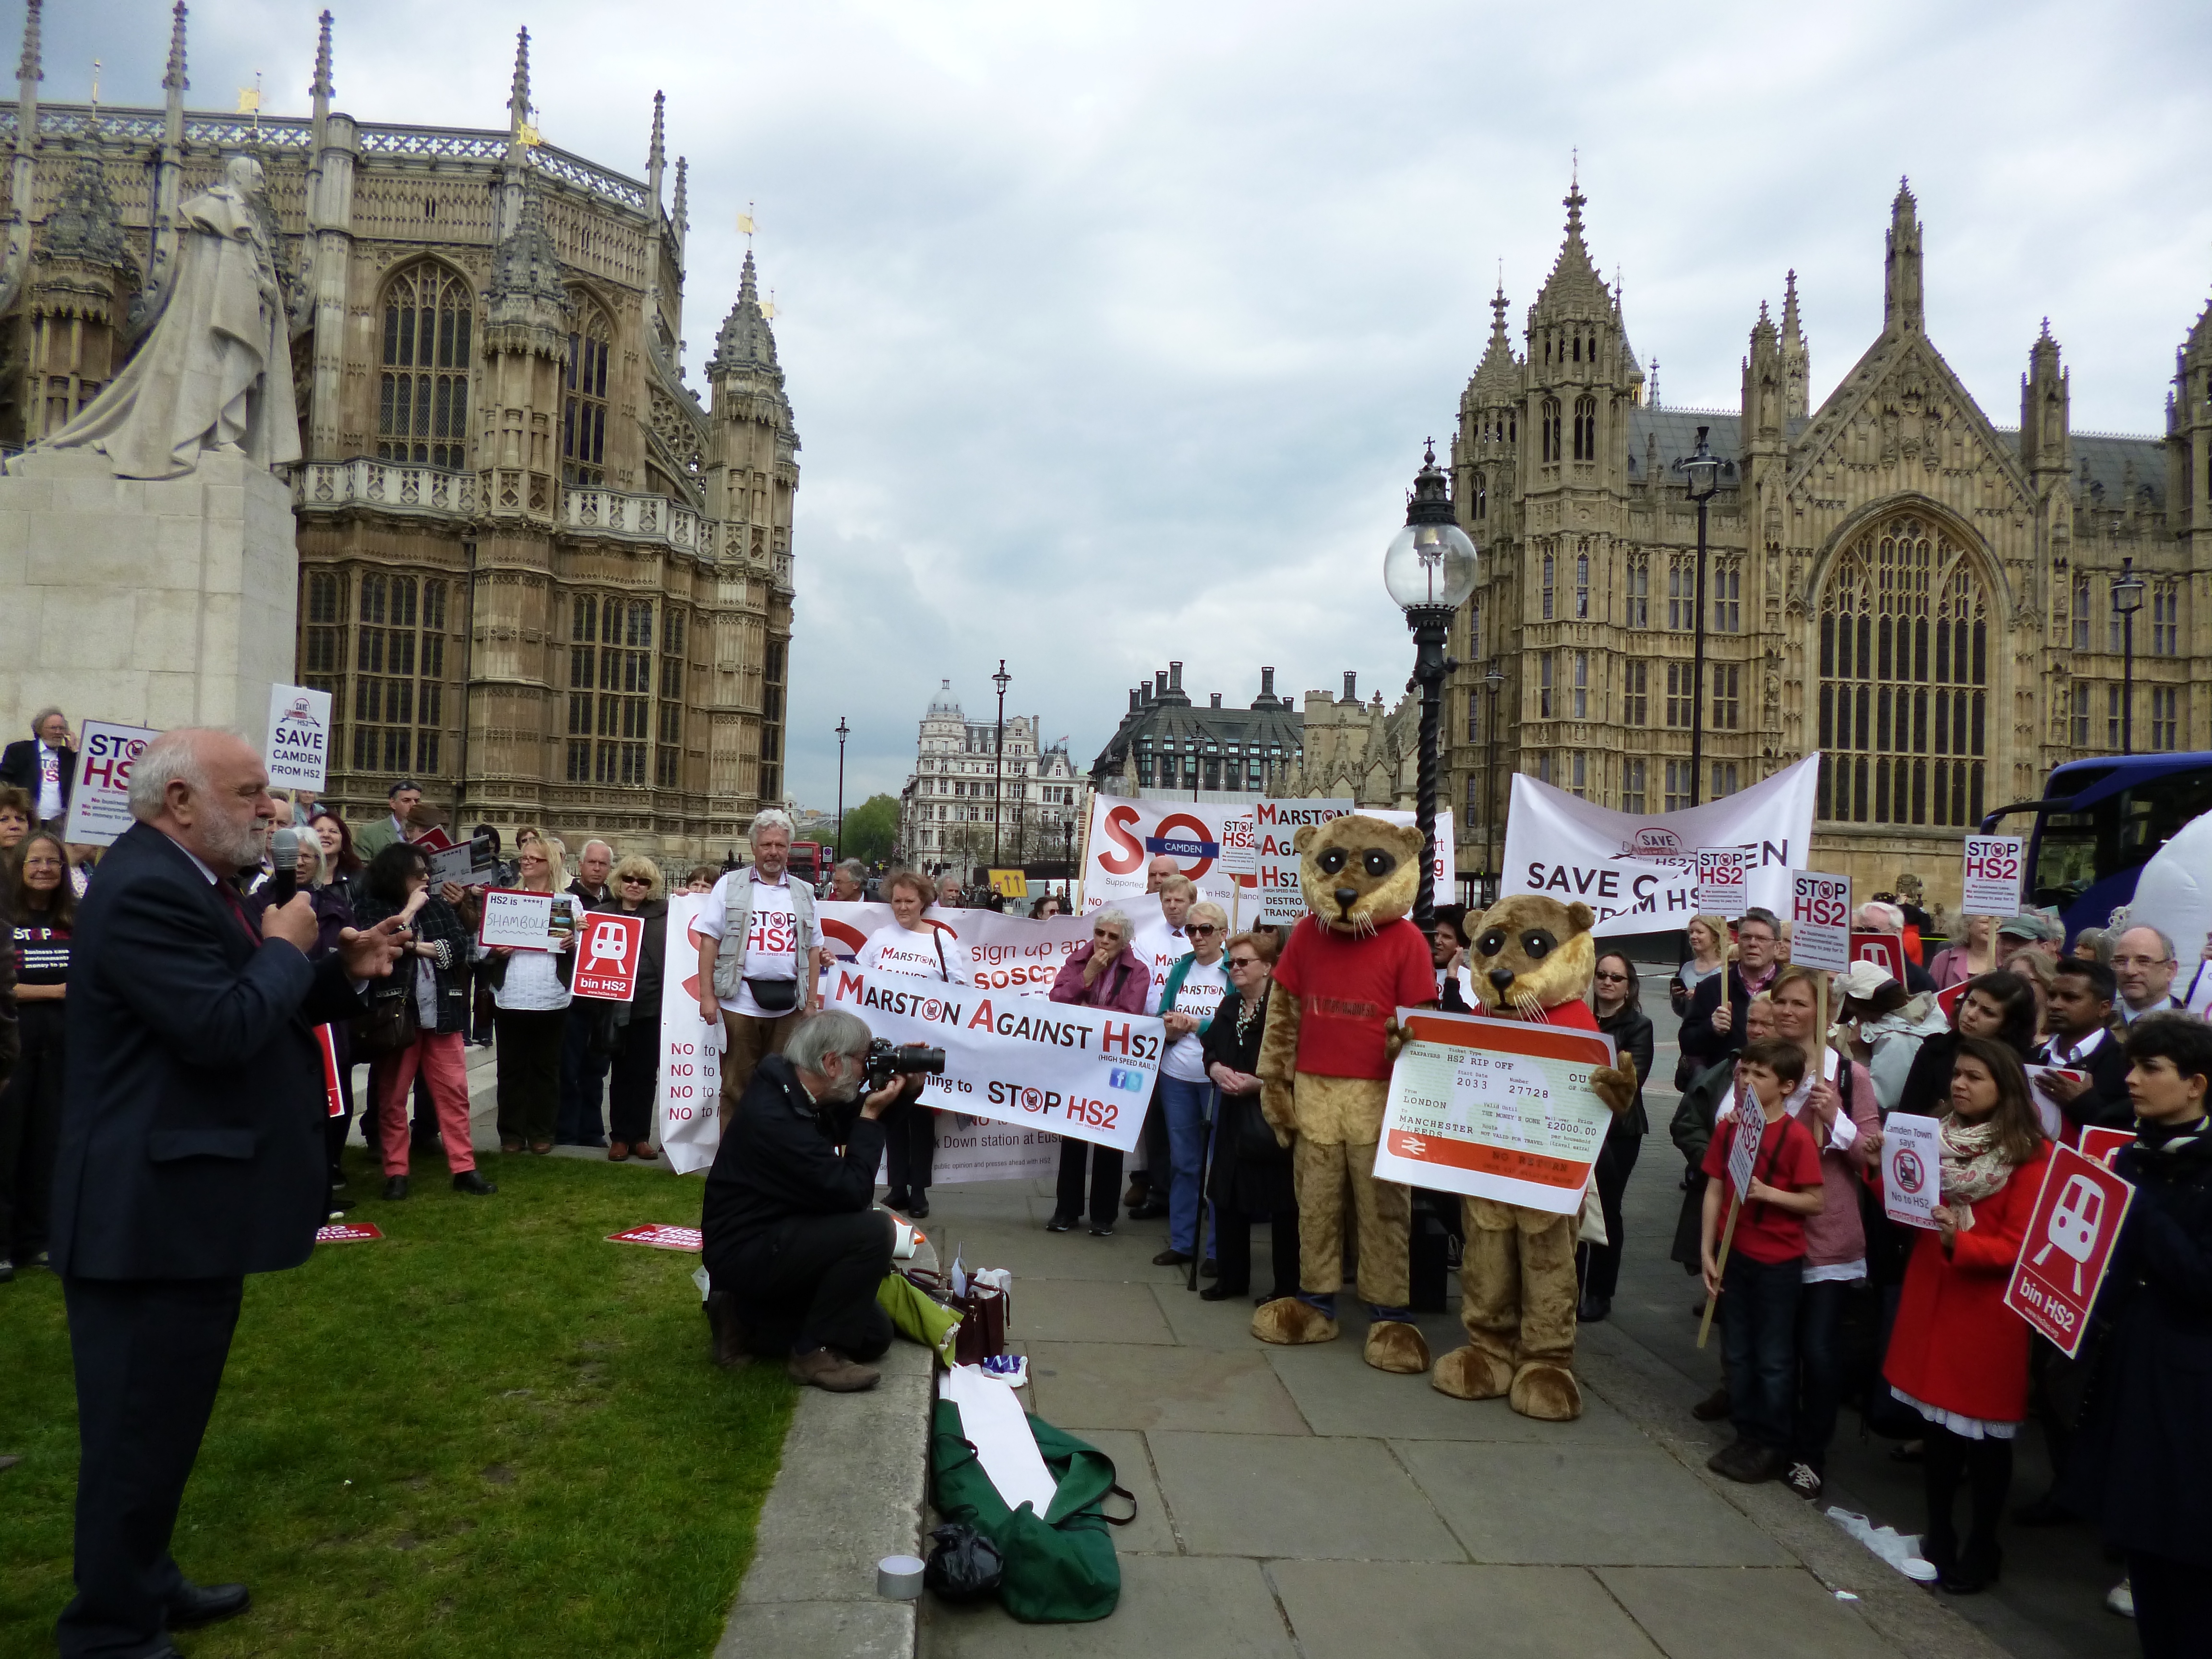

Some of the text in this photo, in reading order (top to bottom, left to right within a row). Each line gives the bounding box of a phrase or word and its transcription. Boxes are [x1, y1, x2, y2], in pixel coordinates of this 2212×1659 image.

[296, 702, 308, 712] SAVE
[275, 727, 323, 749] SAVE
[88, 734, 148, 761] STO
[273, 749, 322, 765] CAMDEN
[83, 757, 135, 791] HS
[271, 765, 320, 779] FROM HS2
[1165, 842, 1202, 854] CAMDEN
[1223, 832, 1254, 848] HS2
[1642, 835, 1675, 846] SAVE
[1968, 842, 2019, 858] STOP
[1655, 858, 1687, 867] HS2
[1700, 853, 1743, 866] STOP
[1700, 866, 1743, 885] HS2
[1966, 857, 2018, 879] HS2
[1106, 878, 1144, 889] Supported
[1261, 866, 1298, 887] HS2
[1526, 862, 1620, 899] SAVE
[1795, 878, 1847, 900] STOP
[490, 896, 518, 906] HS2 is
[1088, 897, 1103, 906] NO
[1667, 887, 1698, 911] HS
[1794, 896, 1846, 927] HS2
[486, 913, 550, 929] SHAMBOLIC
[746, 928, 796, 952] HS2
[881, 946, 937, 968] MARSTON
[971, 939, 1087, 965] sign up an
[580, 977, 626, 992] bin HS2
[835, 970, 1158, 1061] MARSTON AGAINST HS2
[671, 1043, 715, 1056] NO to
[1098, 1054, 1151, 1070] (HIGH SPEED RAIL
[1410, 1050, 1514, 1070] TAXPAYERS HS2 RIP OFF
[671, 1063, 715, 1077] NO to
[670, 1085, 714, 1098] NO to
[1457, 1073, 1590, 1098] 2033 27728 OU
[957, 1078, 1119, 1130] to STOP HS2
[1403, 1095, 1447, 1109] LONDON
[669, 1106, 712, 1120] NO to
[1745, 1094, 1762, 1134] STOP
[1399, 1115, 1473, 1134] MANCHESTER
[1547, 1121, 1597, 1136] £2000.00
[1886, 1124, 1932, 1140] Camden Town
[944, 1135, 976, 1148] Down
[981, 1133, 1019, 1147] station
[1023, 1132, 1034, 1144] at
[1563, 1136, 1591, 1144] household
[1739, 1109, 1757, 1162] HS2
[1899, 1138, 1915, 1149] says
[1492, 1151, 1508, 1161] NO
[934, 1162, 950, 1170] public
[1891, 1191, 1929, 1209] No to HS2
[621, 1233, 700, 1246] Madness
[659, 1233, 703, 1241] Otter
[2020, 1276, 2075, 1333] bin HS2
